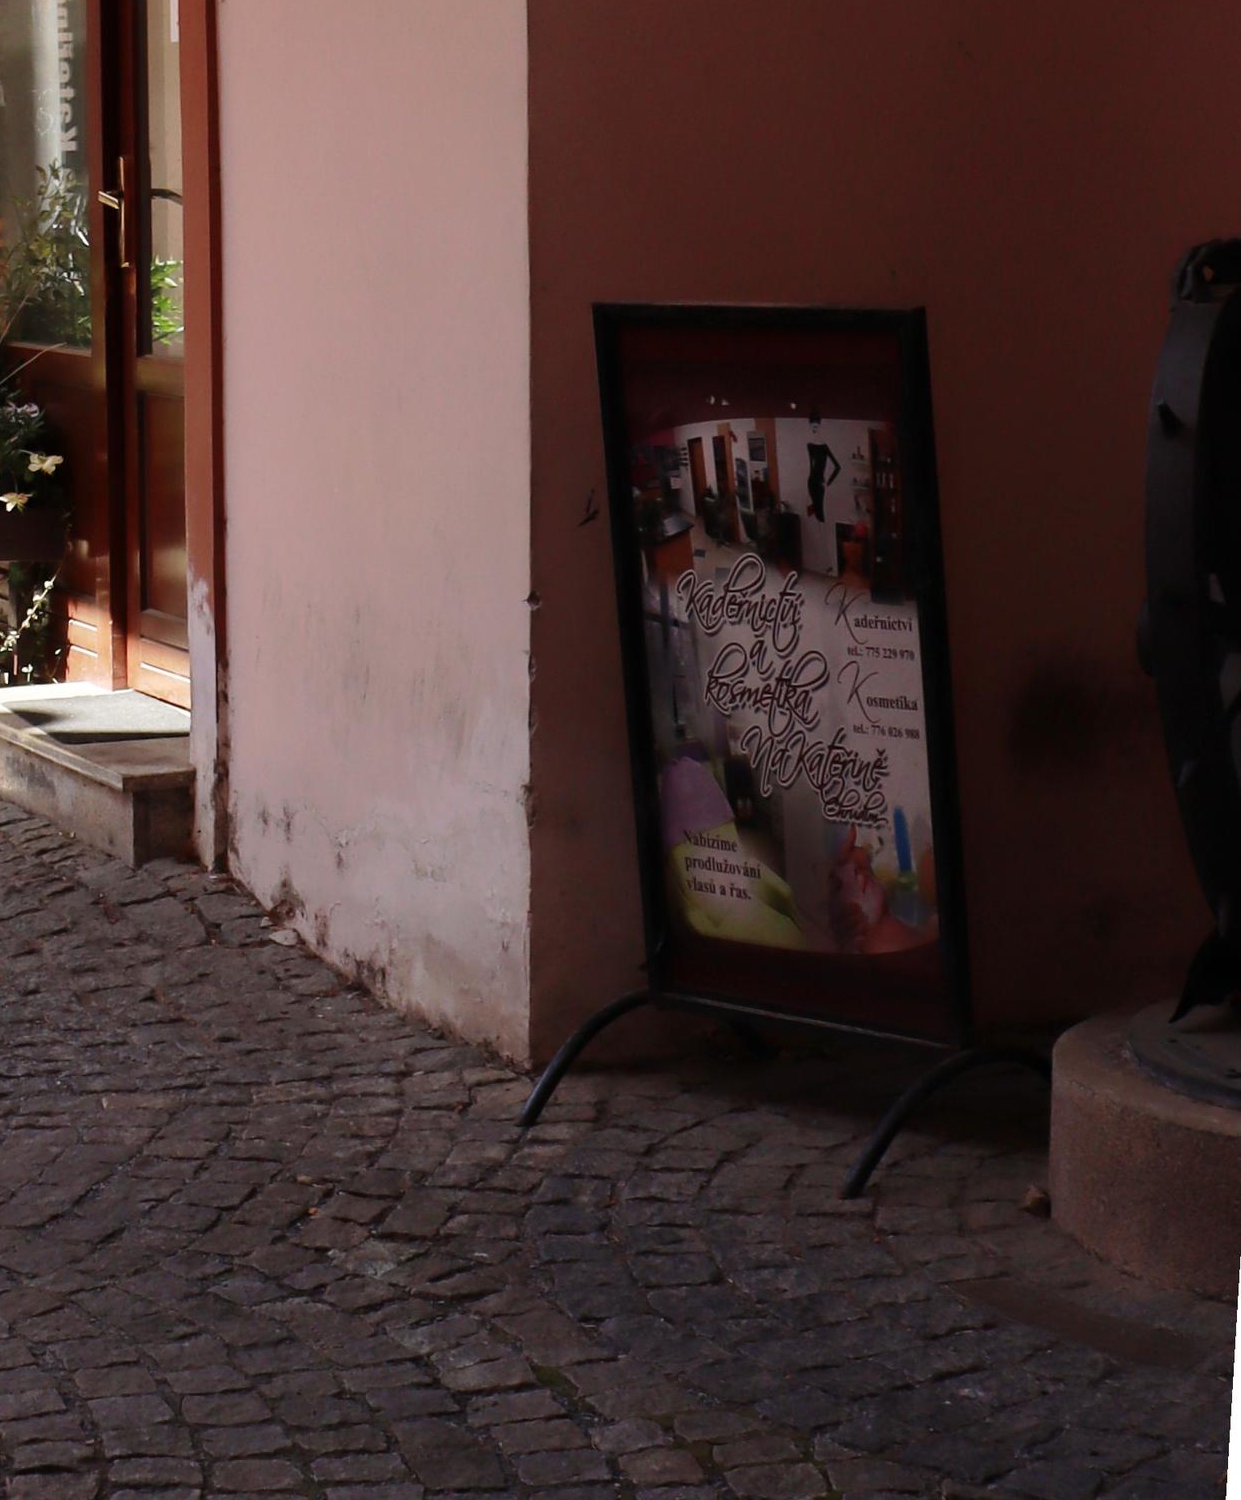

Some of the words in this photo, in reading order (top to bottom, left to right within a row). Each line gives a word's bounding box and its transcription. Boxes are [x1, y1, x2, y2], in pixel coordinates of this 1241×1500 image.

[865, 646, 881, 658] 775
[685, 856, 762, 879] prodlužování
[720, 885, 726, 896] a
